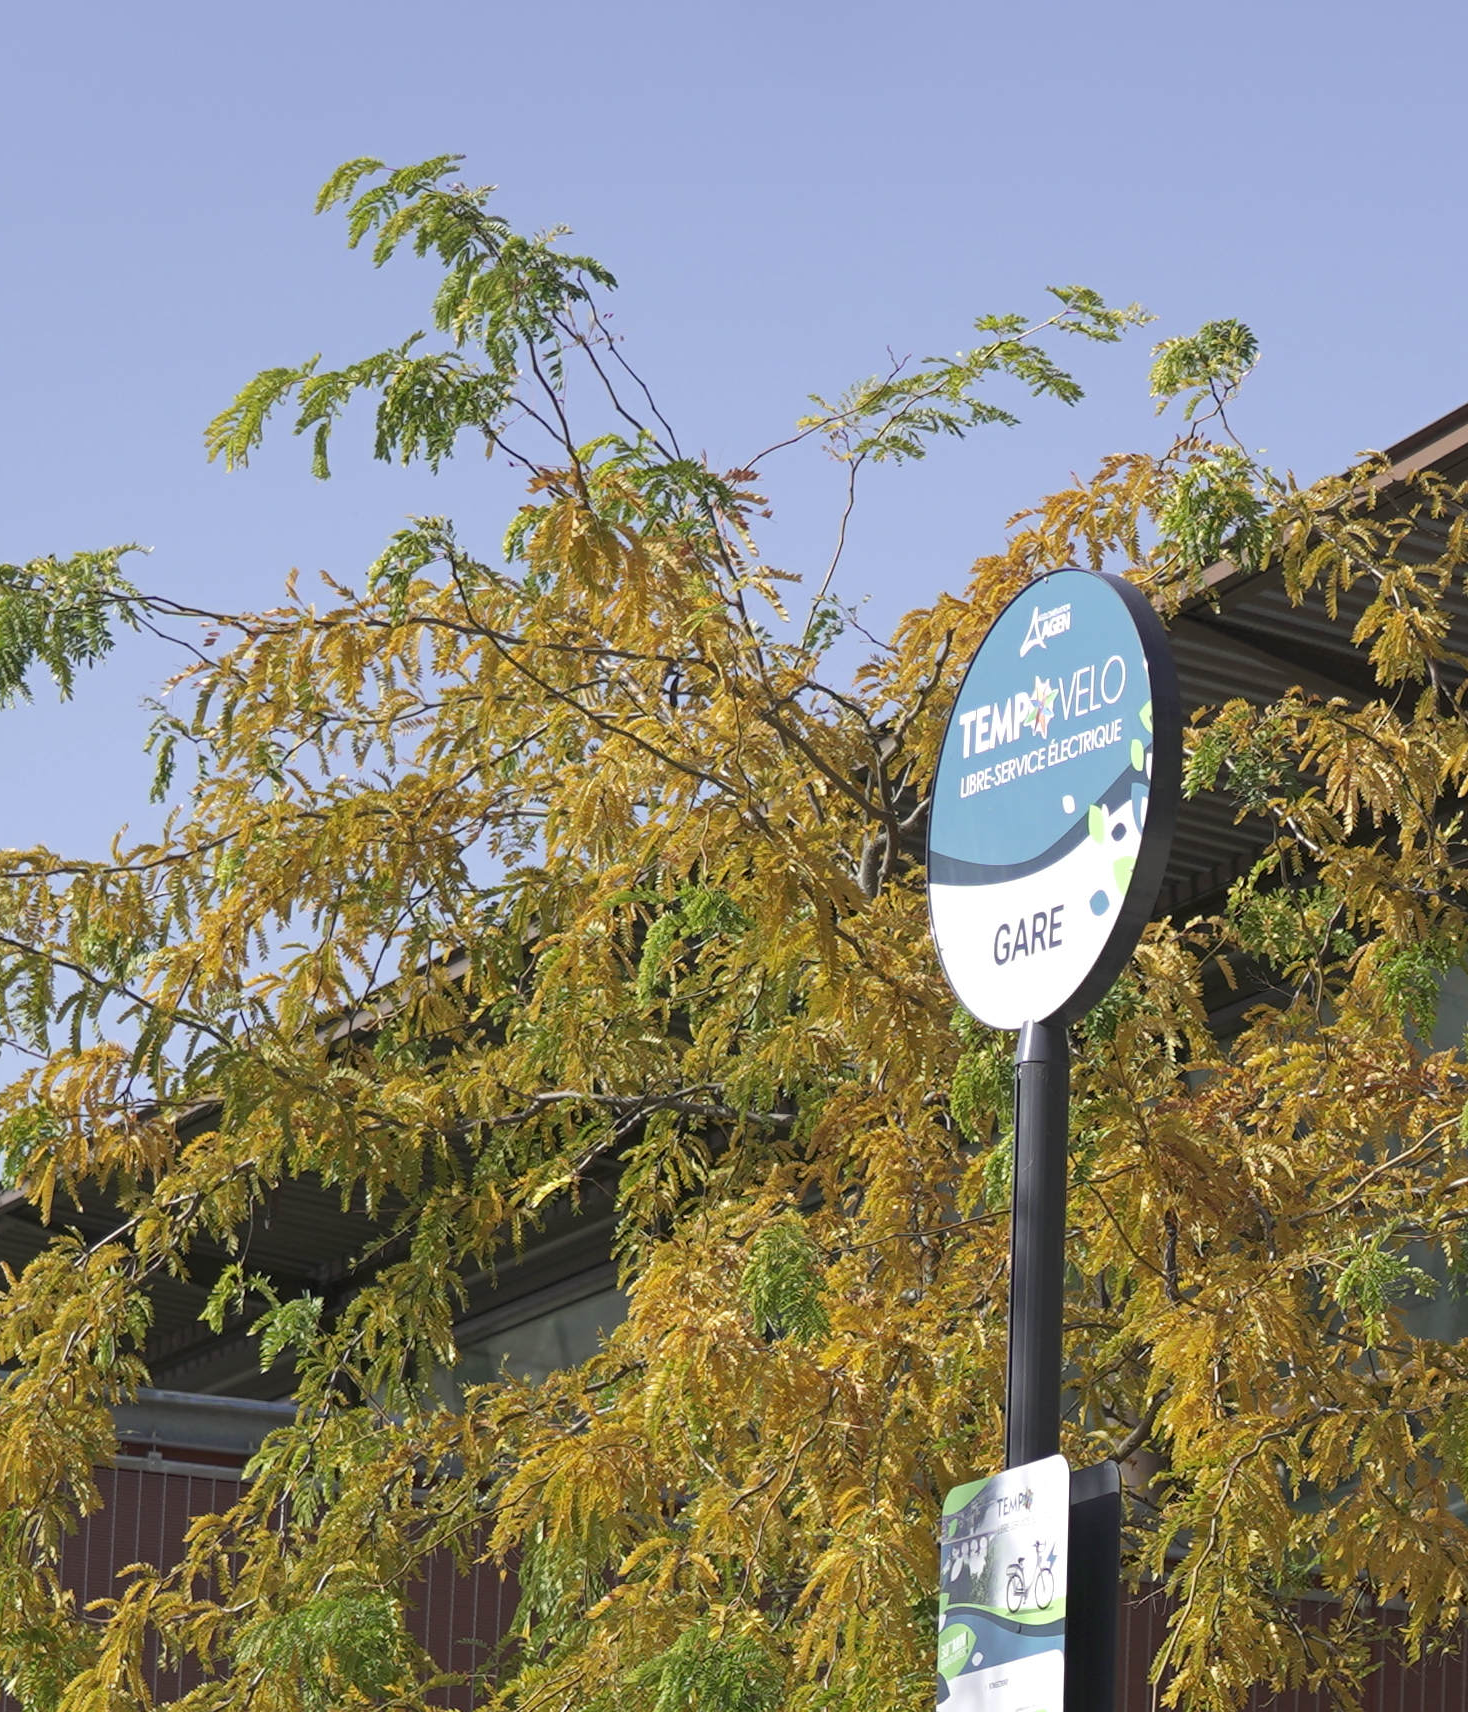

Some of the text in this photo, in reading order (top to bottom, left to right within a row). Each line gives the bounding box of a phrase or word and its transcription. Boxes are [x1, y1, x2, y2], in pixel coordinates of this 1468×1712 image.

[1041, 611, 1071, 640] AGEN
[1059, 655, 1126, 720] VELO
[960, 718, 1122, 798] LIBRE-SERVICE ÉLECTRIQUE
[993, 904, 1064, 966] GARE
